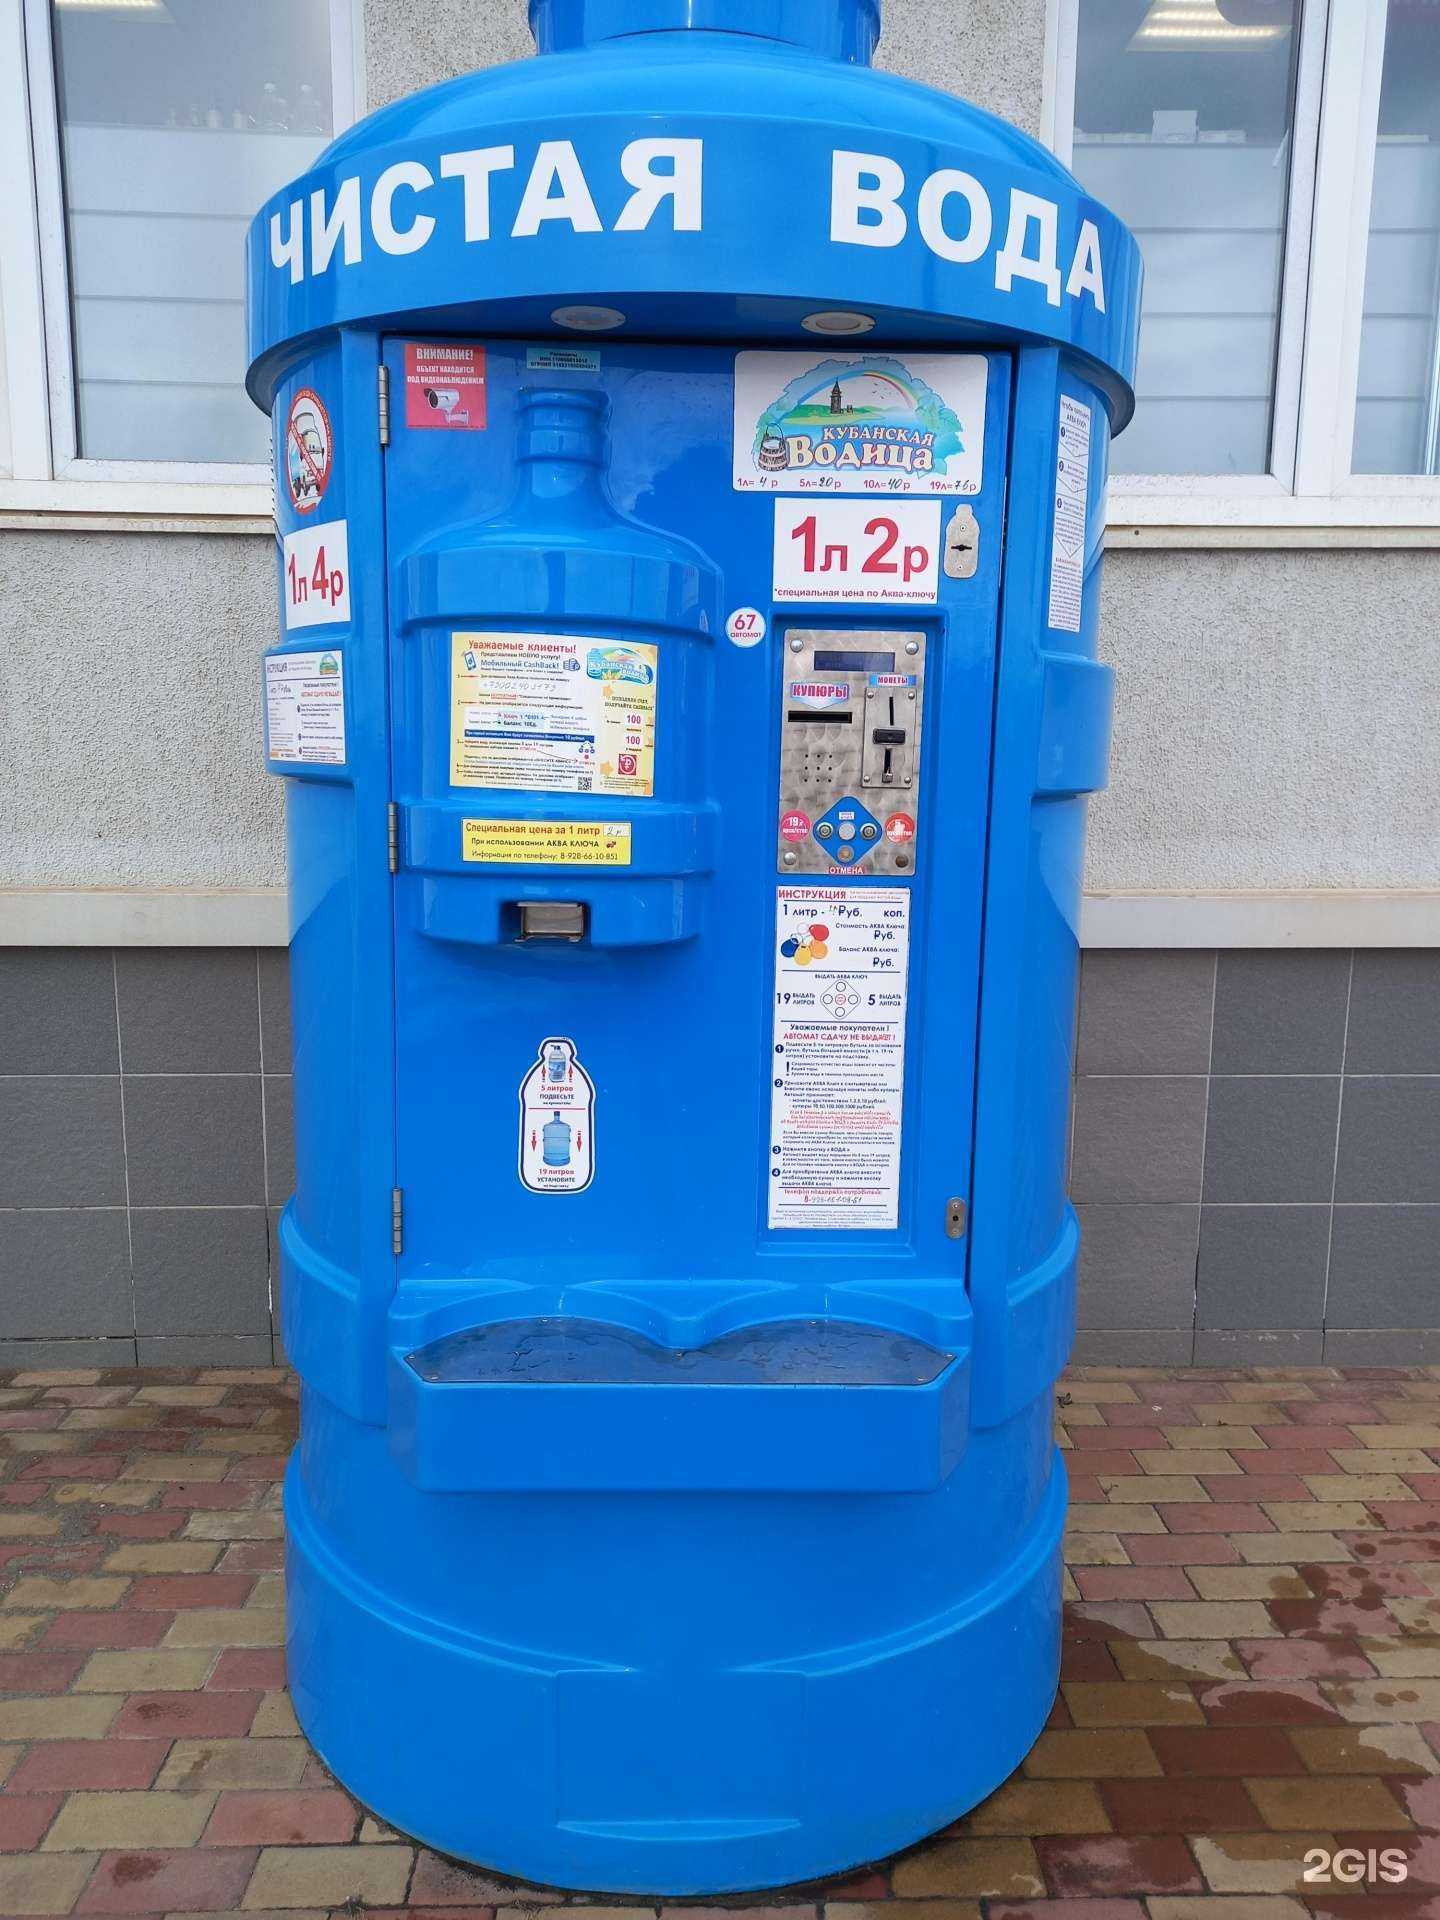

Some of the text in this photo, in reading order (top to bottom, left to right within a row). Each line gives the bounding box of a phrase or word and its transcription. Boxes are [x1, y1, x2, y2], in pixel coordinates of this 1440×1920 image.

[270, 139, 1107, 314] ЧИСТАЯ ВОДА
[417, 348, 473, 360] ВНИМАНИЕ!
[823, 427, 935, 447] КУБАНСКАЯ
[786, 436, 934, 474] Водица
[791, 516, 929, 582] 1л 2р
[289, 546, 344, 606] 1л 4р
[841, 589, 864, 599] цена
[867, 590, 878, 598] по
[881, 589, 936, 600] Аква-ключу
[734, 614, 756, 630] 67
[469, 640, 576, 653] Уважаемые клиенты!
[481, 660, 559, 669] Мобильный CashBack!
[877, 676, 907, 684] МОНЕТЫ
[792, 684, 847, 698] КУПЮРЫ
[627, 714, 641, 724] 100
[626, 735, 640, 745] 100
[789, 817, 798, 827] 19
[466, 823, 600, 836] Специальная цена за 1 литр
[486, 839, 544, 847] использовании
[472, 851, 511, 859] Информация
[524, 852, 558, 860] телефону:
[560, 852, 618, 860] 8-928-66-10-851
[778, 890, 846, 899] ИНСТРУКЦИЯ
[784, 904, 787, 915] 1
[793, 909, 817, 918] литр
[884, 910, 905, 918] коп.
[777, 993, 790, 1004] 19
[868, 994, 875, 1006] 5
